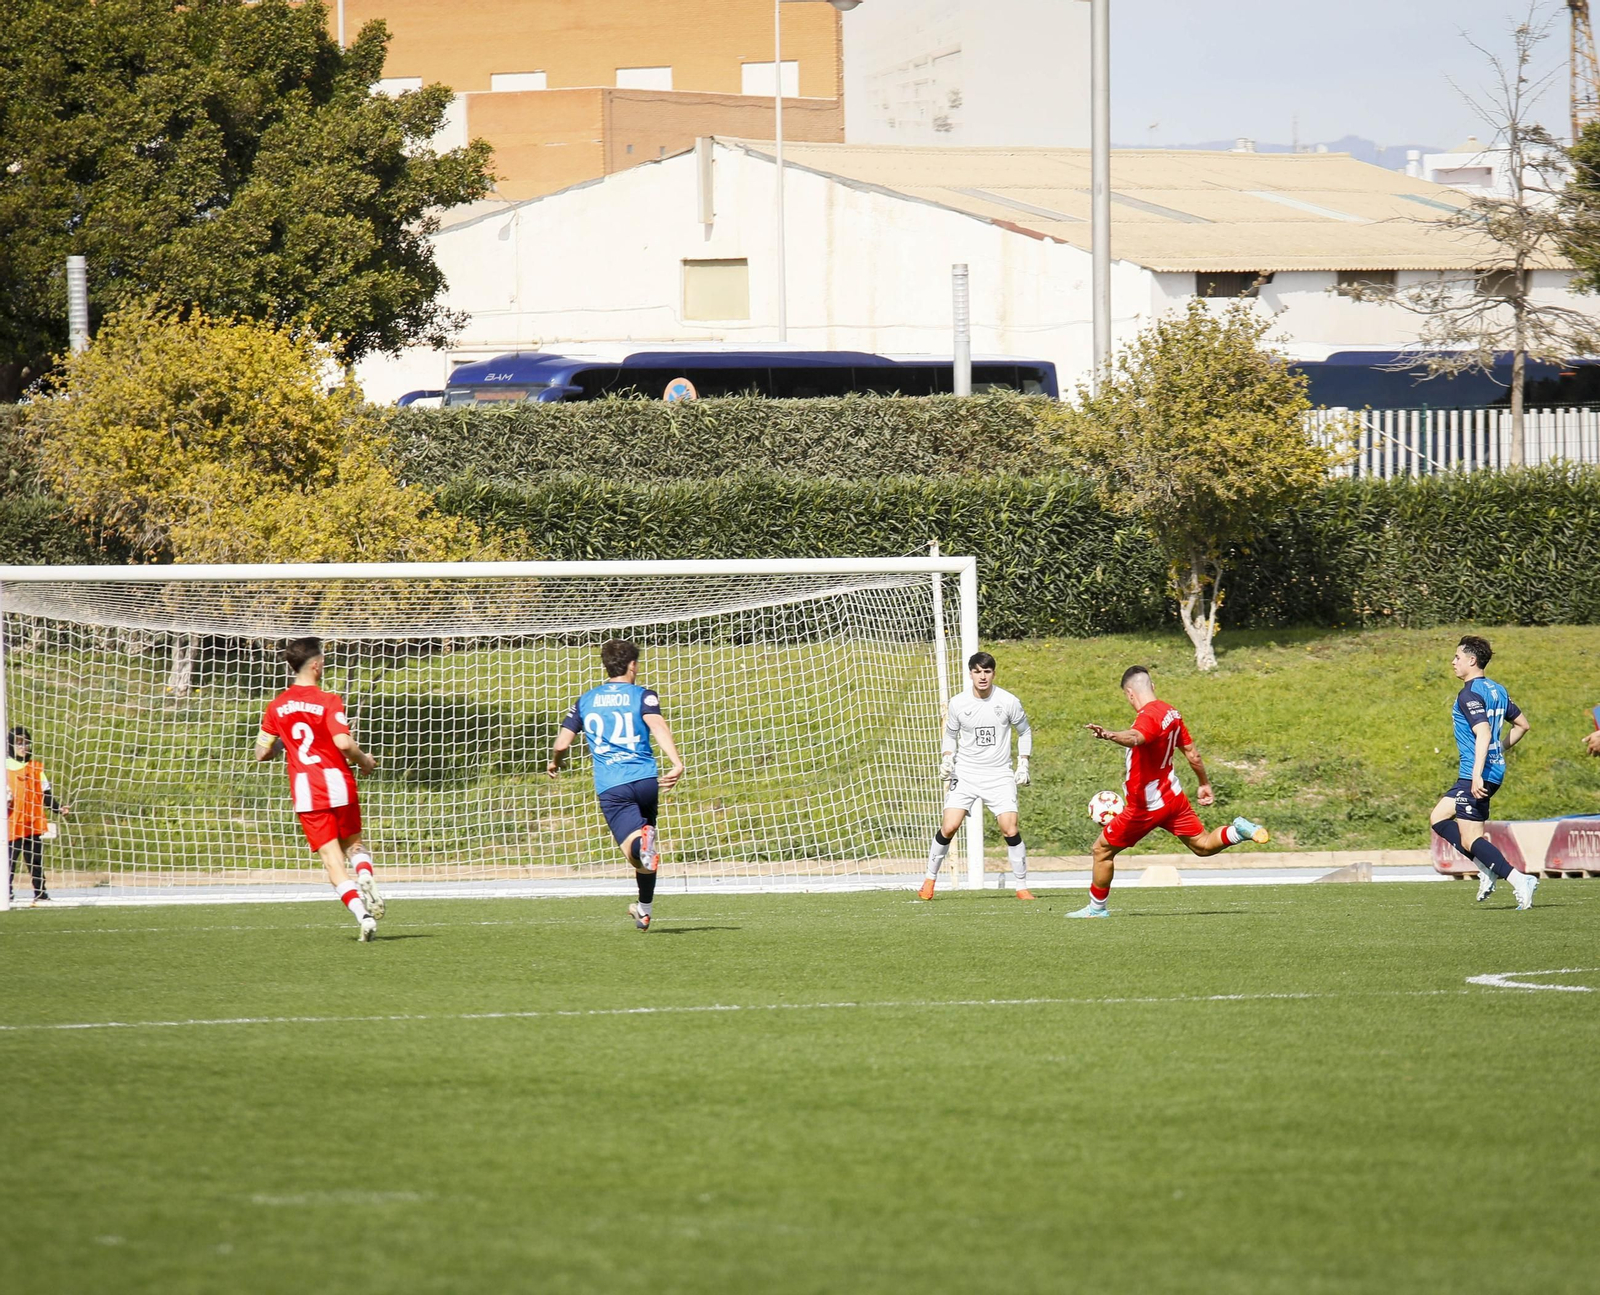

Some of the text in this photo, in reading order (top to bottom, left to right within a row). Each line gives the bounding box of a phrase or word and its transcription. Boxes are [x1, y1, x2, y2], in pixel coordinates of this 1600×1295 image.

[484, 373, 514, 381] BAM
[291, 722, 321, 765] 2
[584, 711, 640, 754] 24
